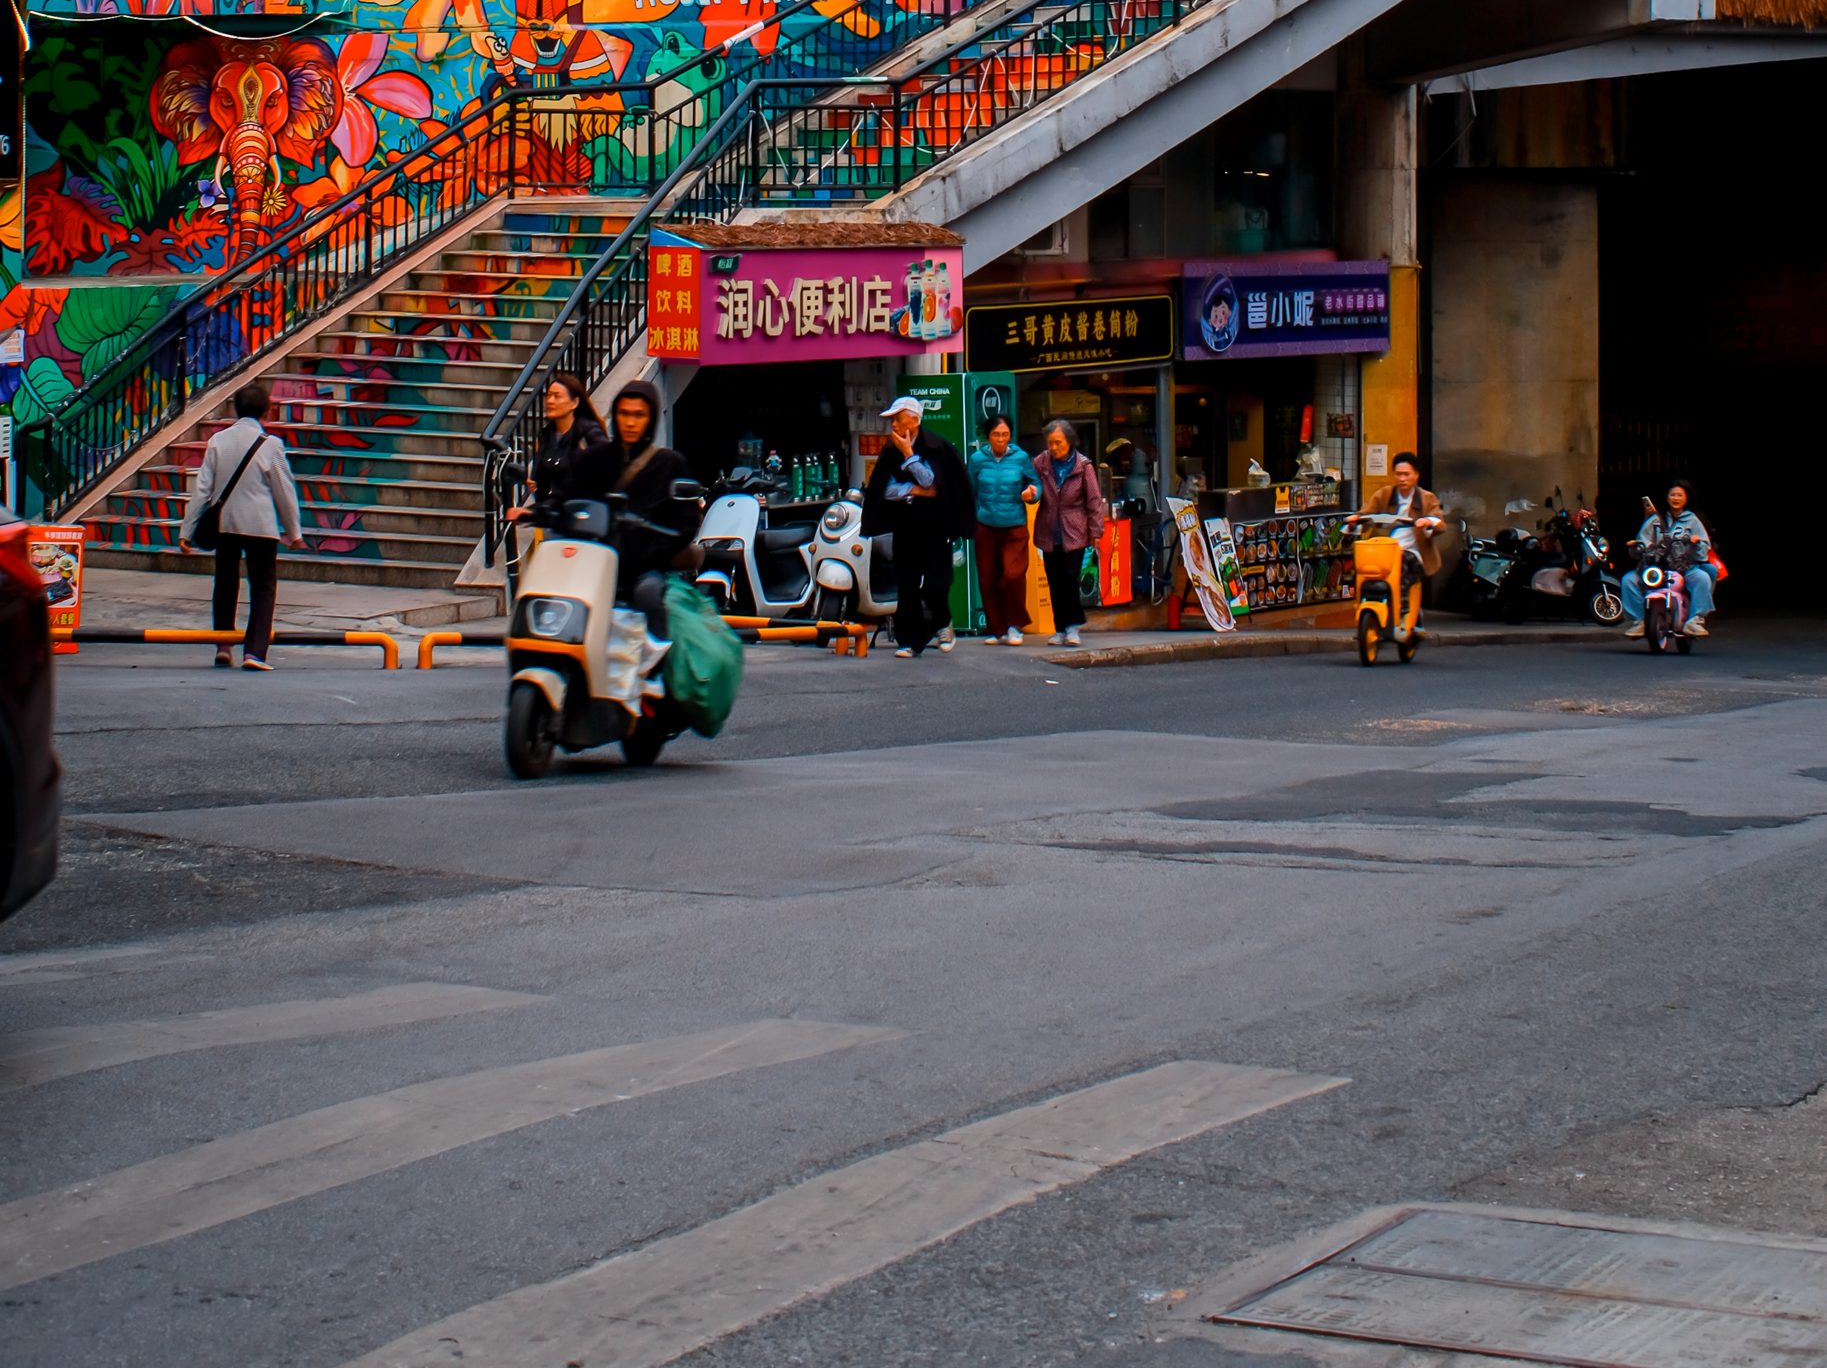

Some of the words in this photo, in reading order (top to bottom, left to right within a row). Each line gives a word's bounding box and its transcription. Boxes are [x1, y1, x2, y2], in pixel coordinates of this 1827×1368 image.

[656, 253, 692, 277] 啤酒
[656, 289, 692, 314] 饮料
[716, 275, 892, 339] 润心便利店
[1248, 291, 1314, 329] 邕小妮
[648, 326, 699, 351] 冰淇淋
[1005, 309, 1139, 346] 三哥黄皮酱卷筒粉
[909, 388, 928, 396] TEAM
[929, 387, 950, 395] CHINA
